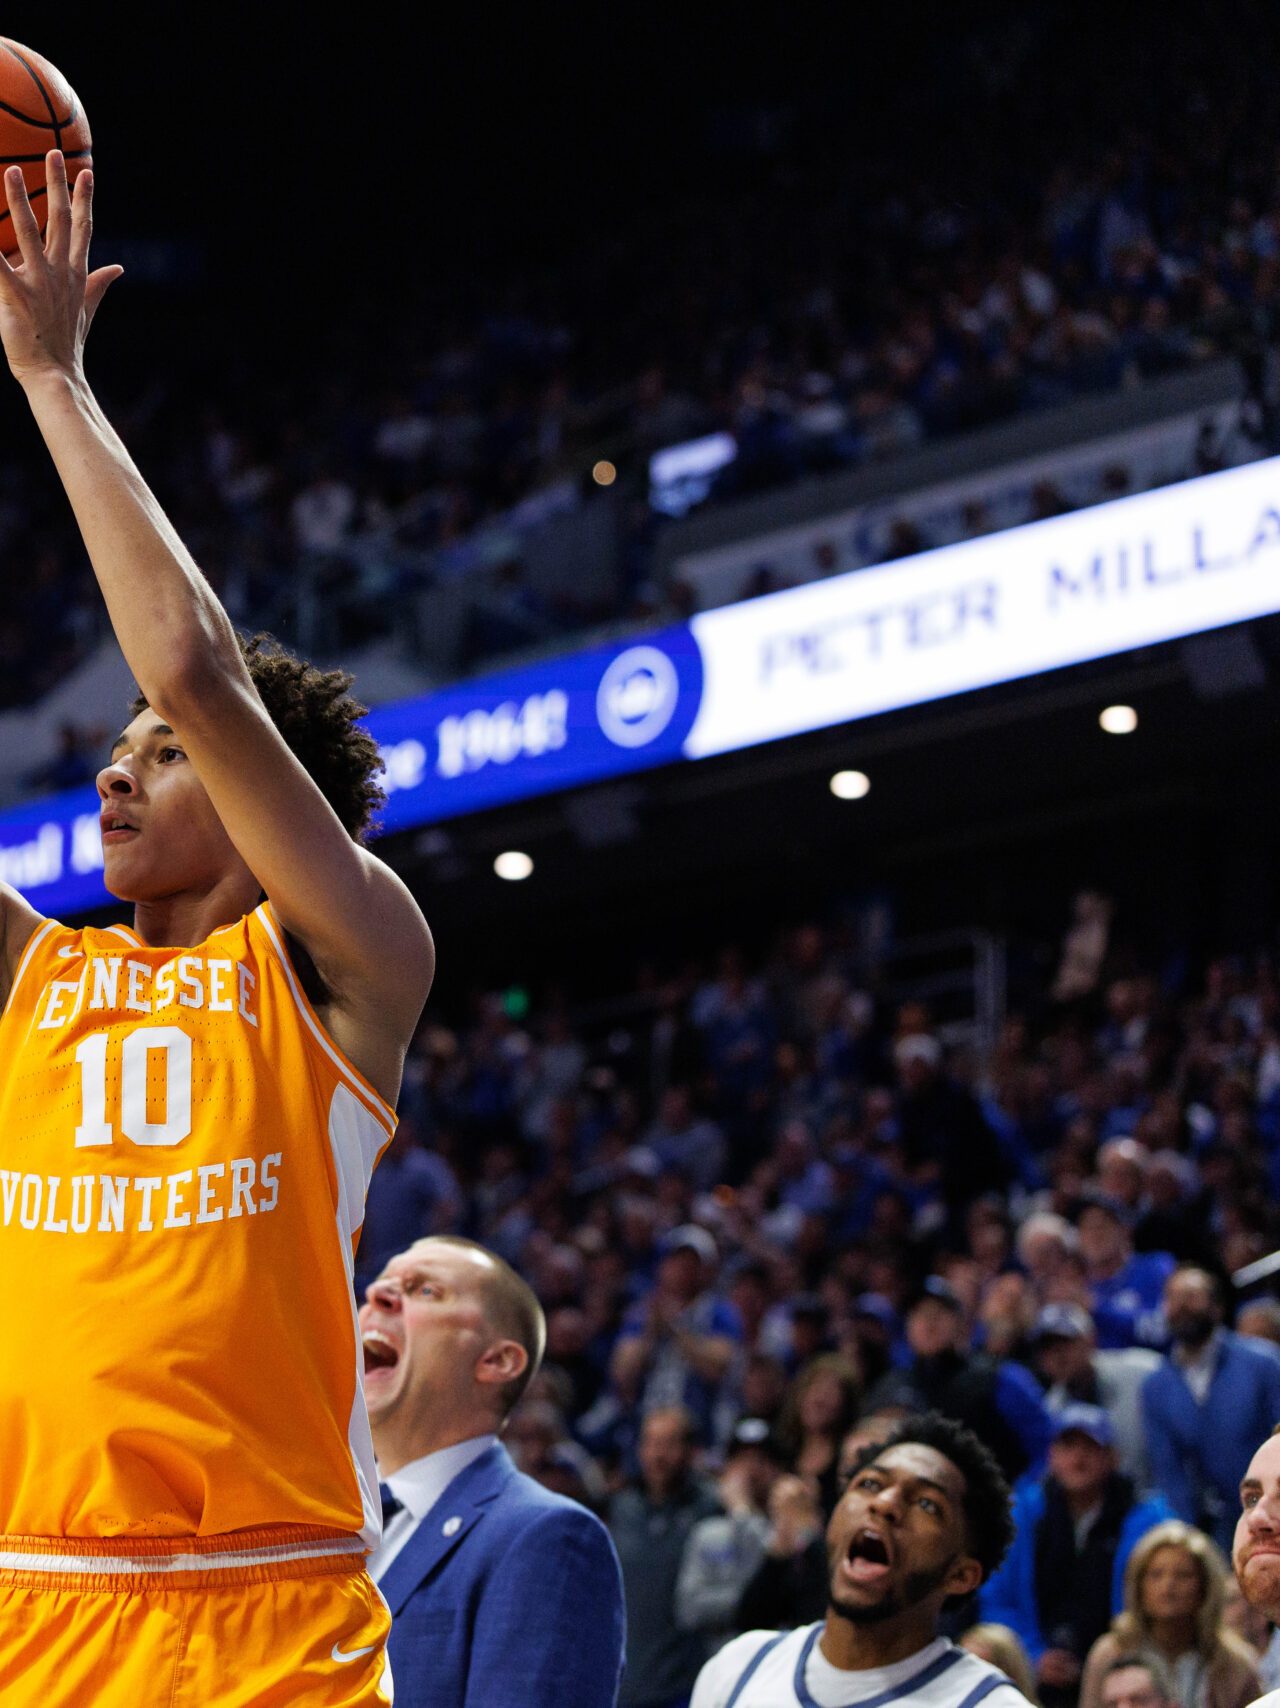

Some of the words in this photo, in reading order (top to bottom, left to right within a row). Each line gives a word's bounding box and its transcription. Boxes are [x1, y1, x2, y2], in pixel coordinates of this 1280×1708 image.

[755, 578, 1002, 690] PETER
[74, 1025, 193, 1149] 10
[0, 1151, 283, 1234] VOLUNTEERS
